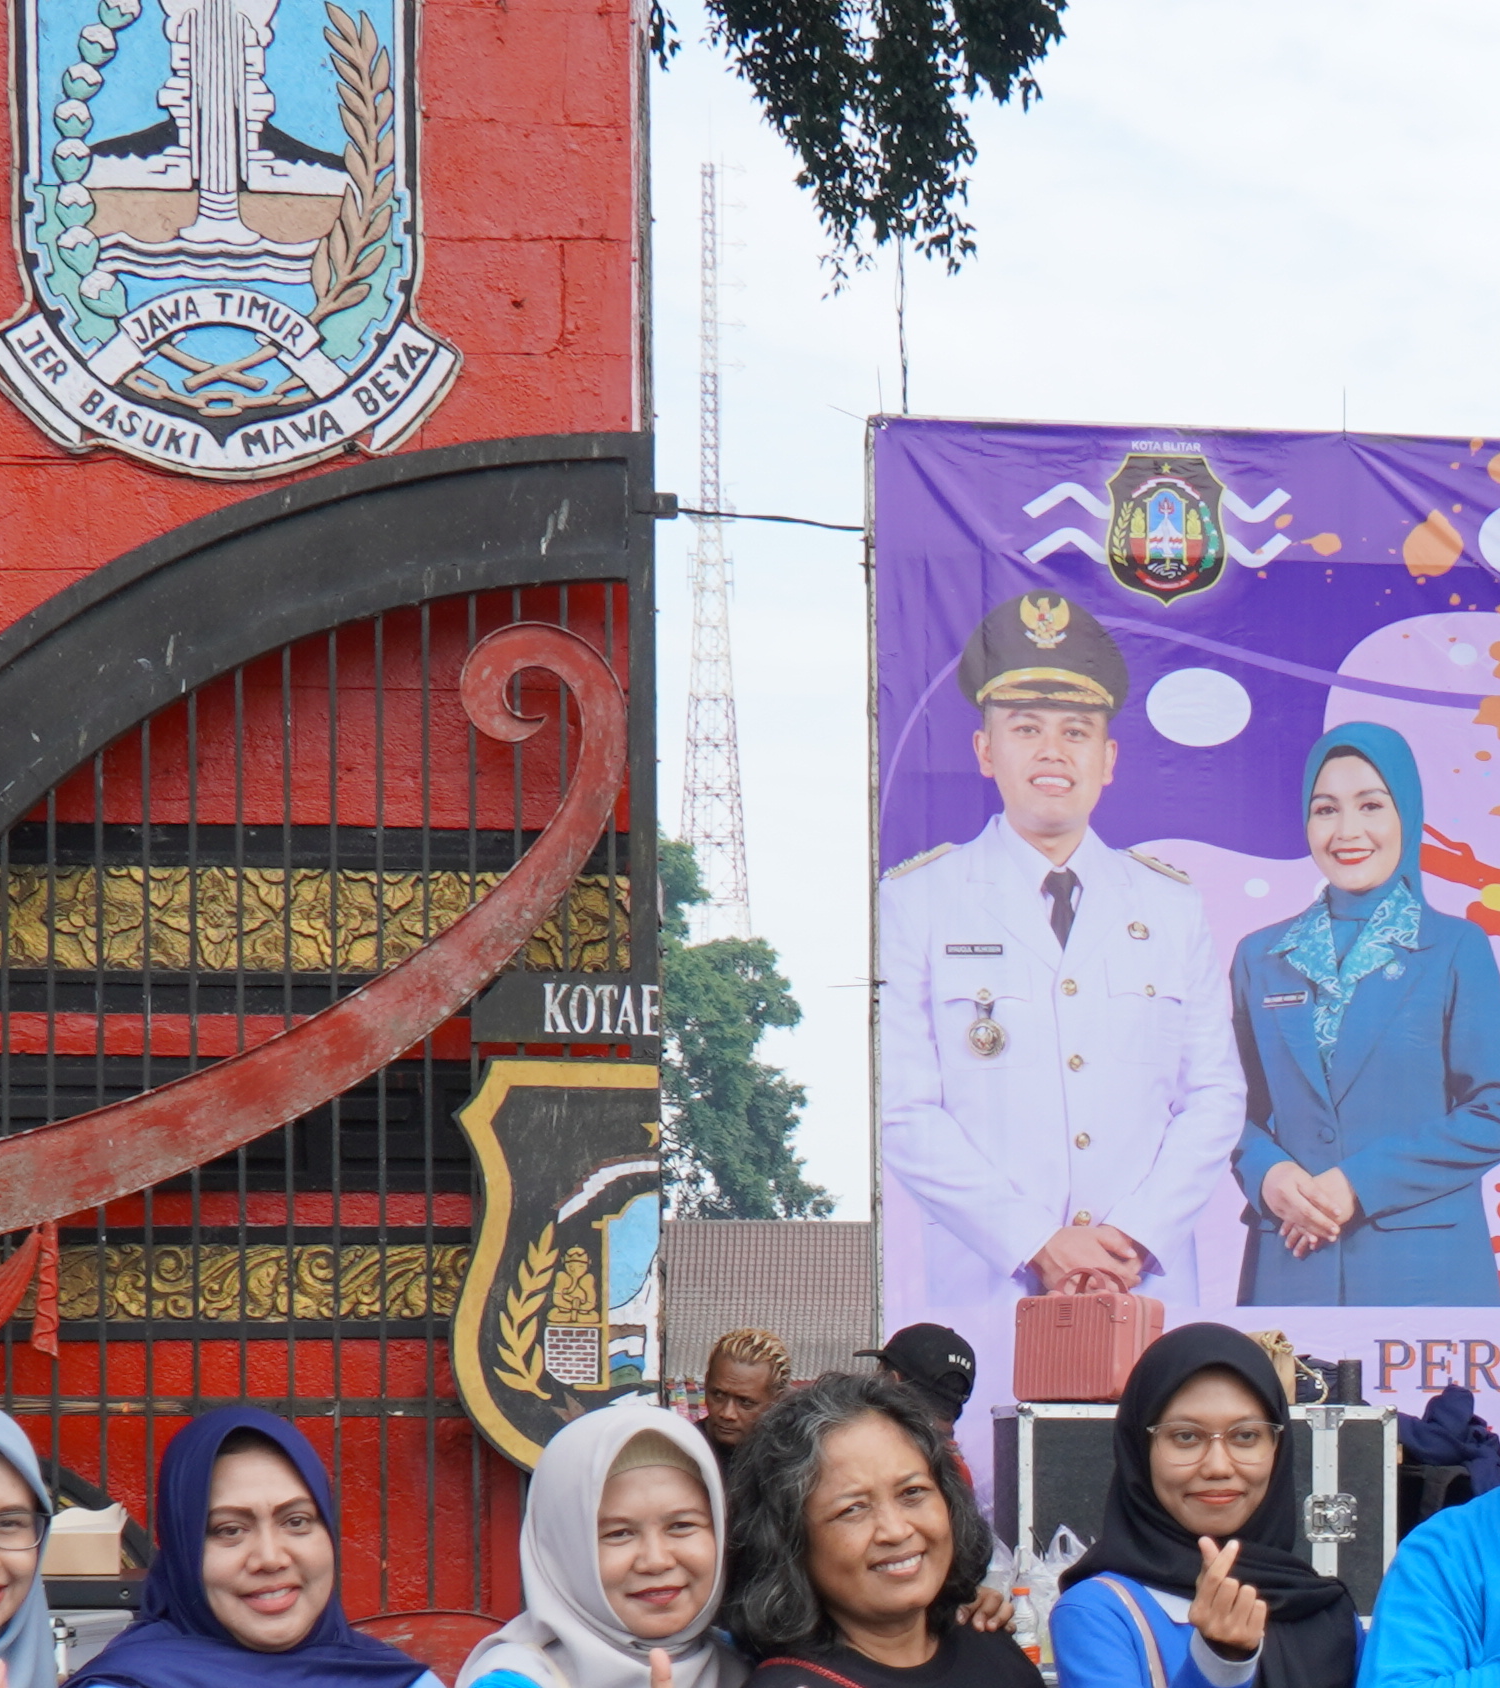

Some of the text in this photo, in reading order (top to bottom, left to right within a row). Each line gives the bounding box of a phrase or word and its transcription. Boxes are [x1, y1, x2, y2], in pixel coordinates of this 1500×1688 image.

[135, 293, 304, 348] JAWA TIMUR
[19, 330, 429, 460] JER BASUKI MAWA BEYA
[1131, 440, 1202, 453] KOTA BLITAR
